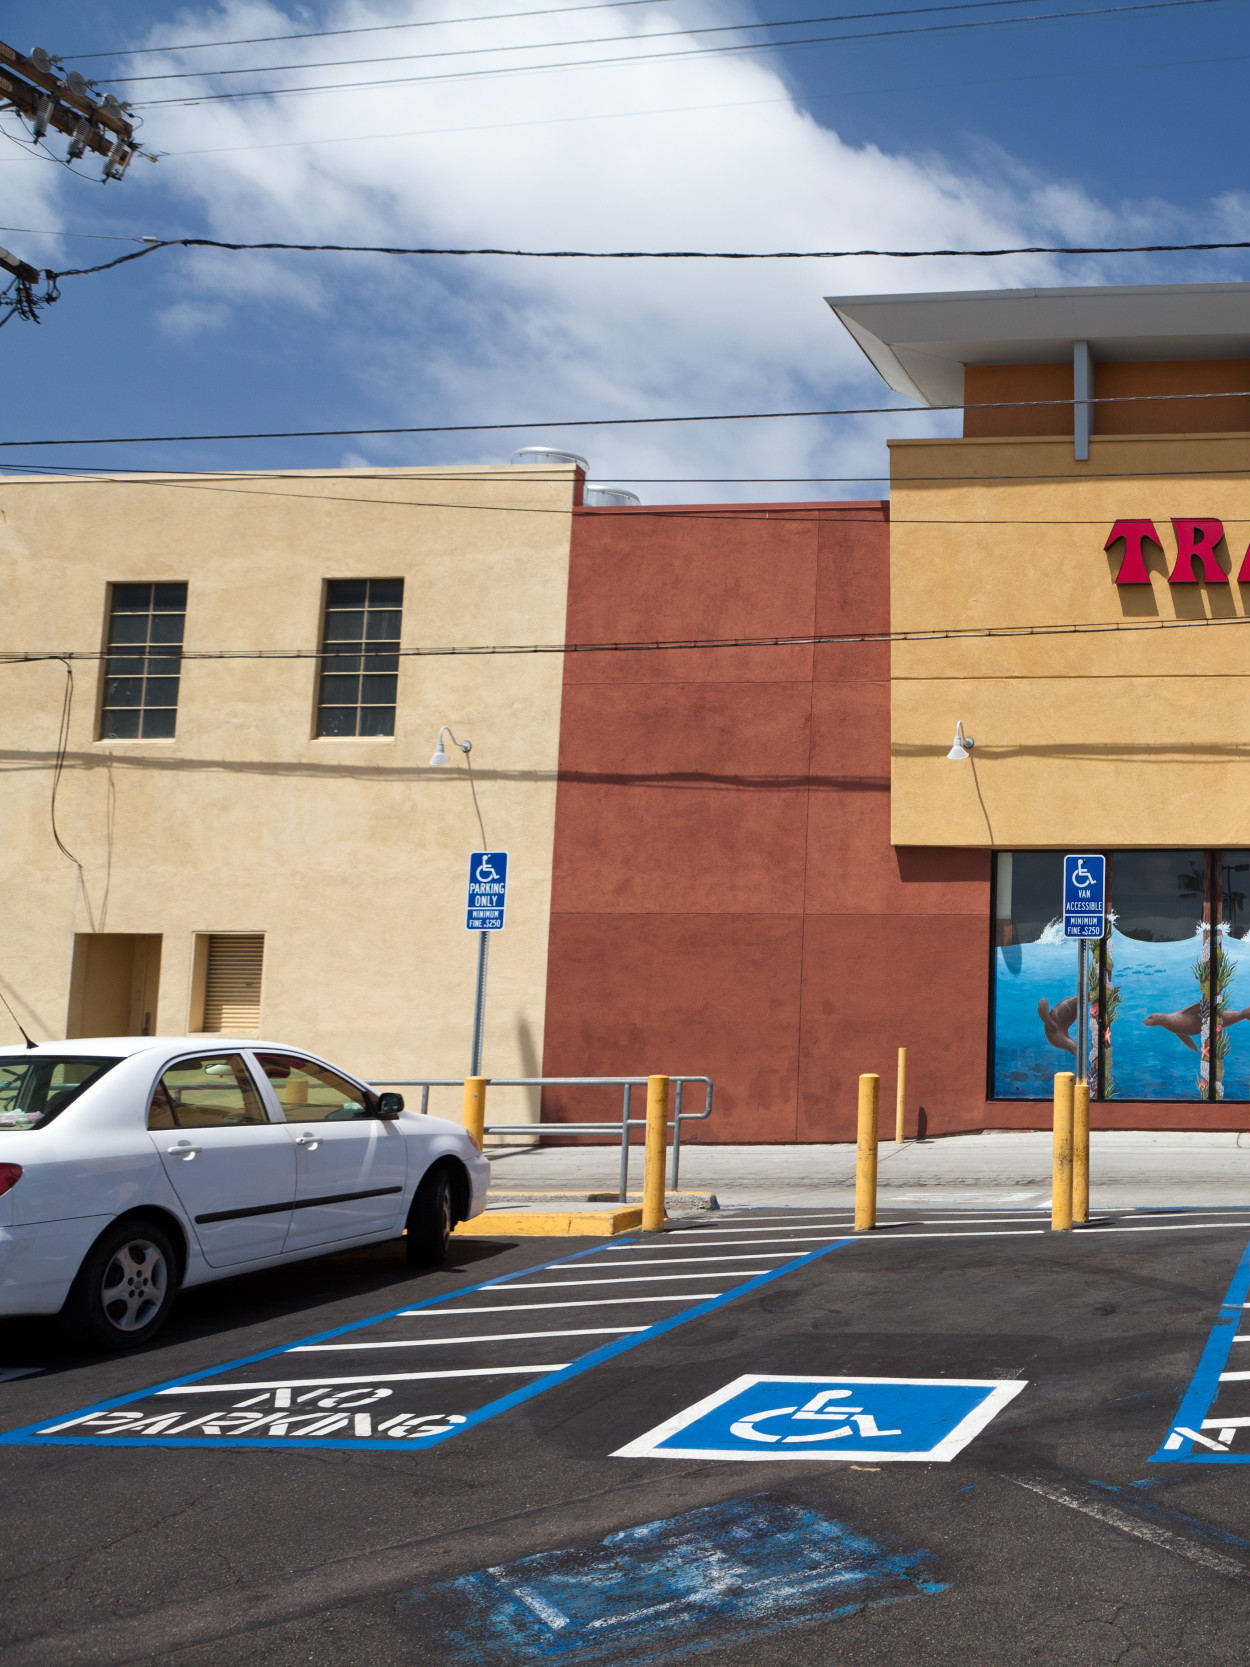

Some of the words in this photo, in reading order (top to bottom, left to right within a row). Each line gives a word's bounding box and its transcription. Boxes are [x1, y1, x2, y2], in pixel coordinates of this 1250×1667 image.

[469, 883, 505, 894] PARKING
[1078, 890, 1091, 898] VAN
[474, 896, 498, 907] ONLY
[1066, 902, 1102, 911] ACCESSIBLE
[486, 919, 501, 928] $250
[1070, 917, 1098, 925] MINIMUM
[1067, 927, 1081, 935] FINE
[1084, 926, 1100, 935] $250
[232, 1387, 393, 1408] NO
[37, 1411, 466, 1438] PARKING
